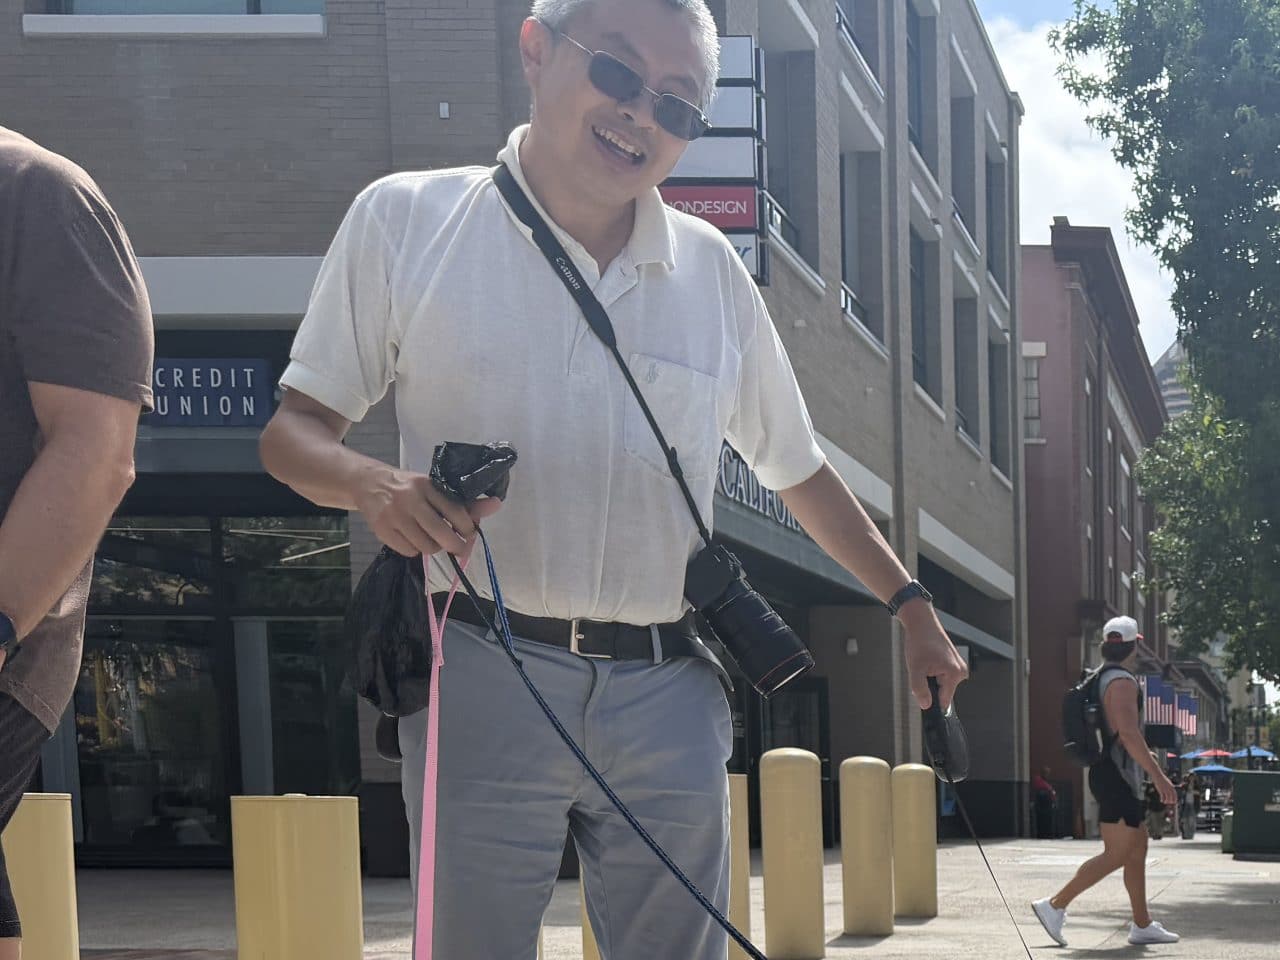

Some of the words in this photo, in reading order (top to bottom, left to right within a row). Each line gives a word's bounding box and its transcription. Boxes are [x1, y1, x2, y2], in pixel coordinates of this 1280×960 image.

[555, 257, 581, 290] Canon
[155, 368, 254, 388] CREDIT
[157, 396, 255, 416] UNION
